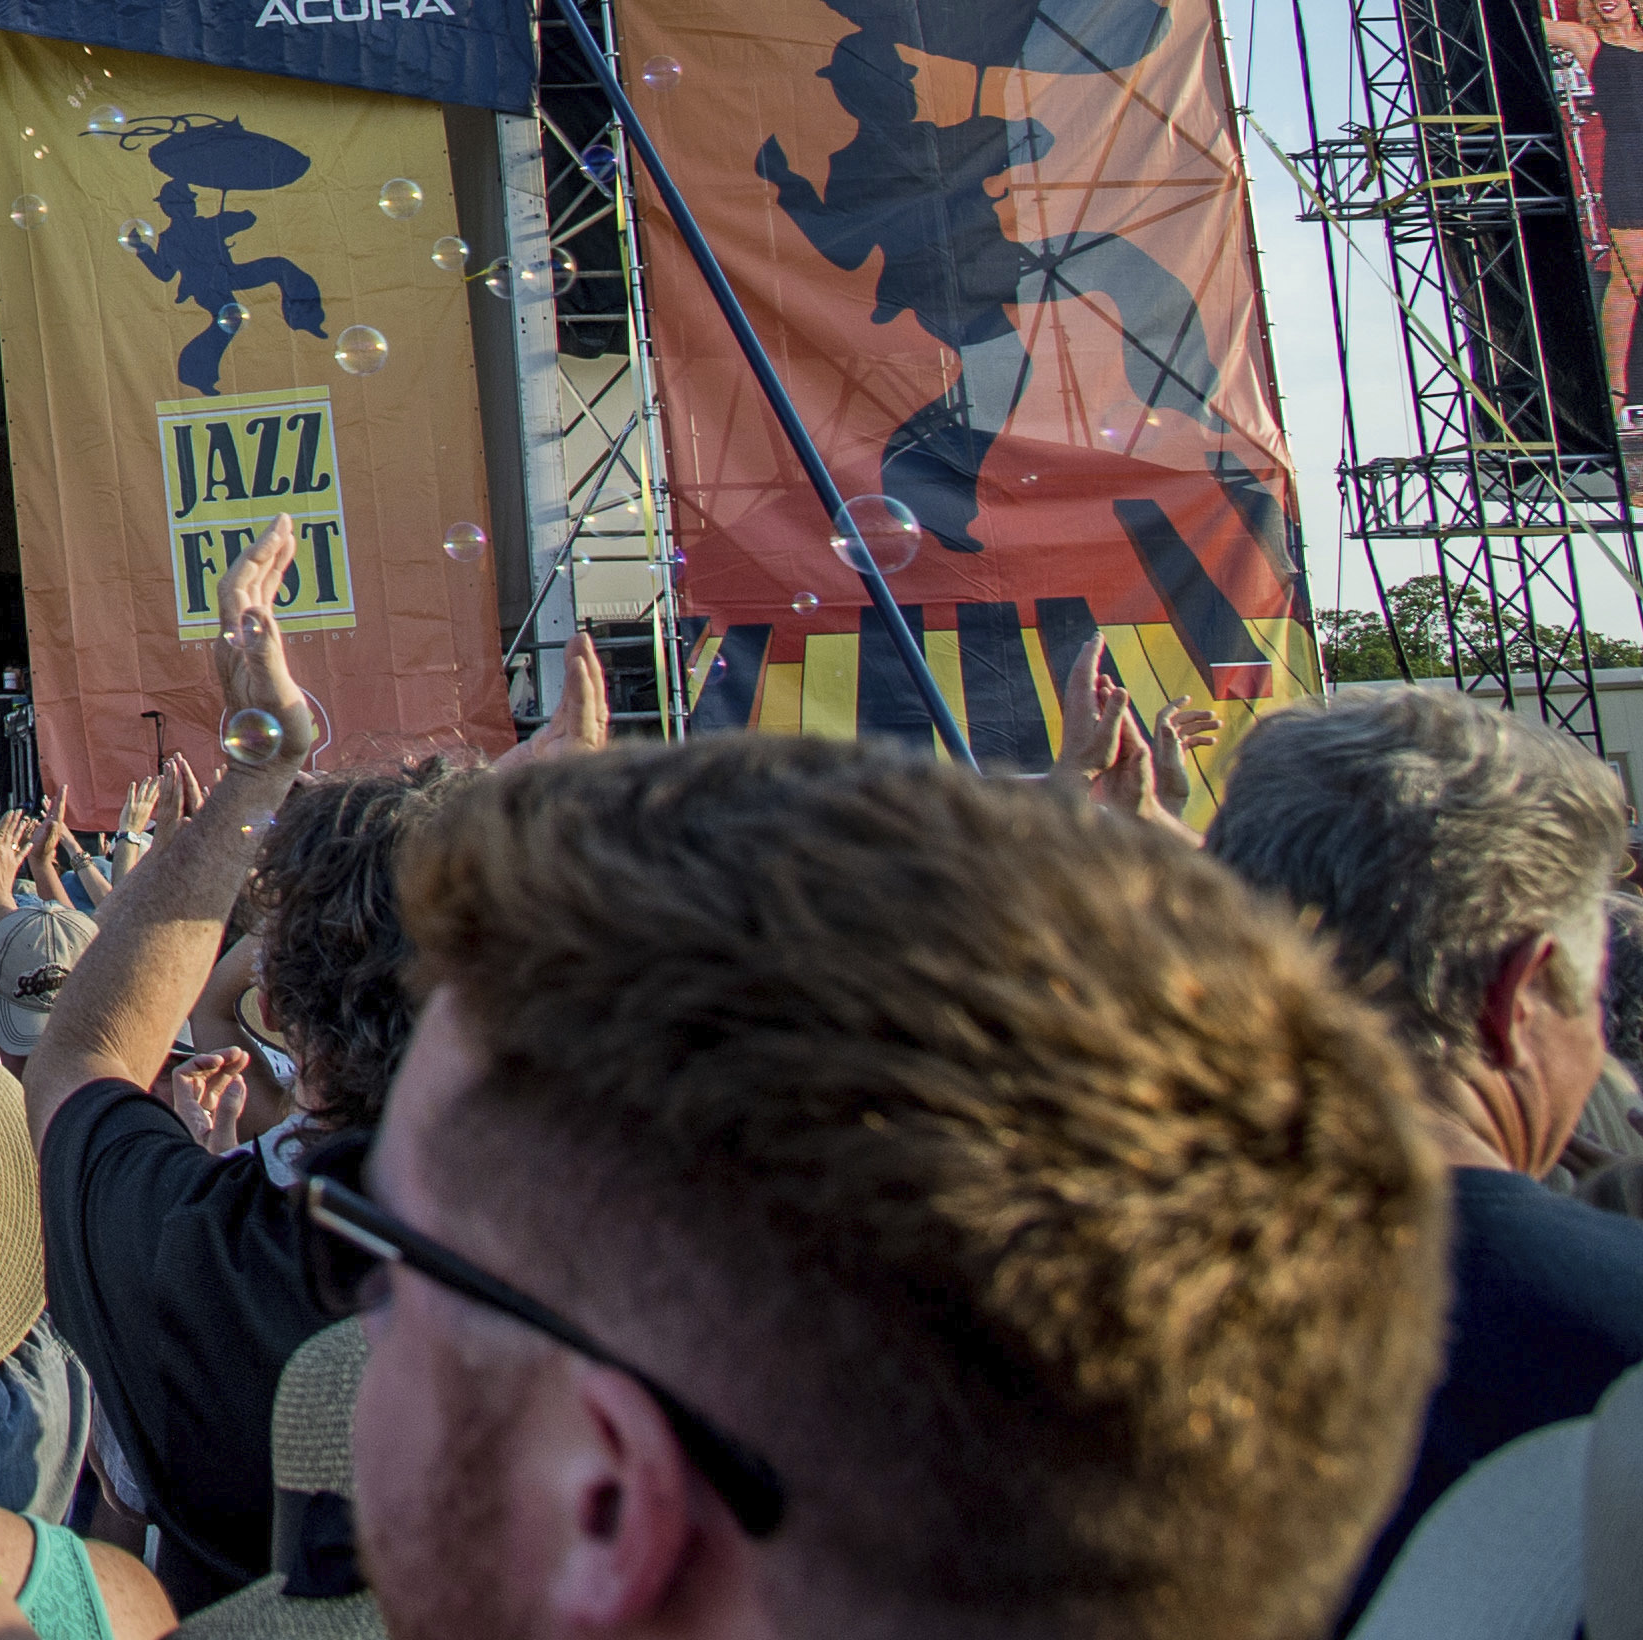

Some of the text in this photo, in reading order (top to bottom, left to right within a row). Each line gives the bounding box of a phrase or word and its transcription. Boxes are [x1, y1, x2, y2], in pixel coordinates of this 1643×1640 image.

[173, 412, 331, 518] JAZZ
[180, 630, 356, 651] PREED BY
